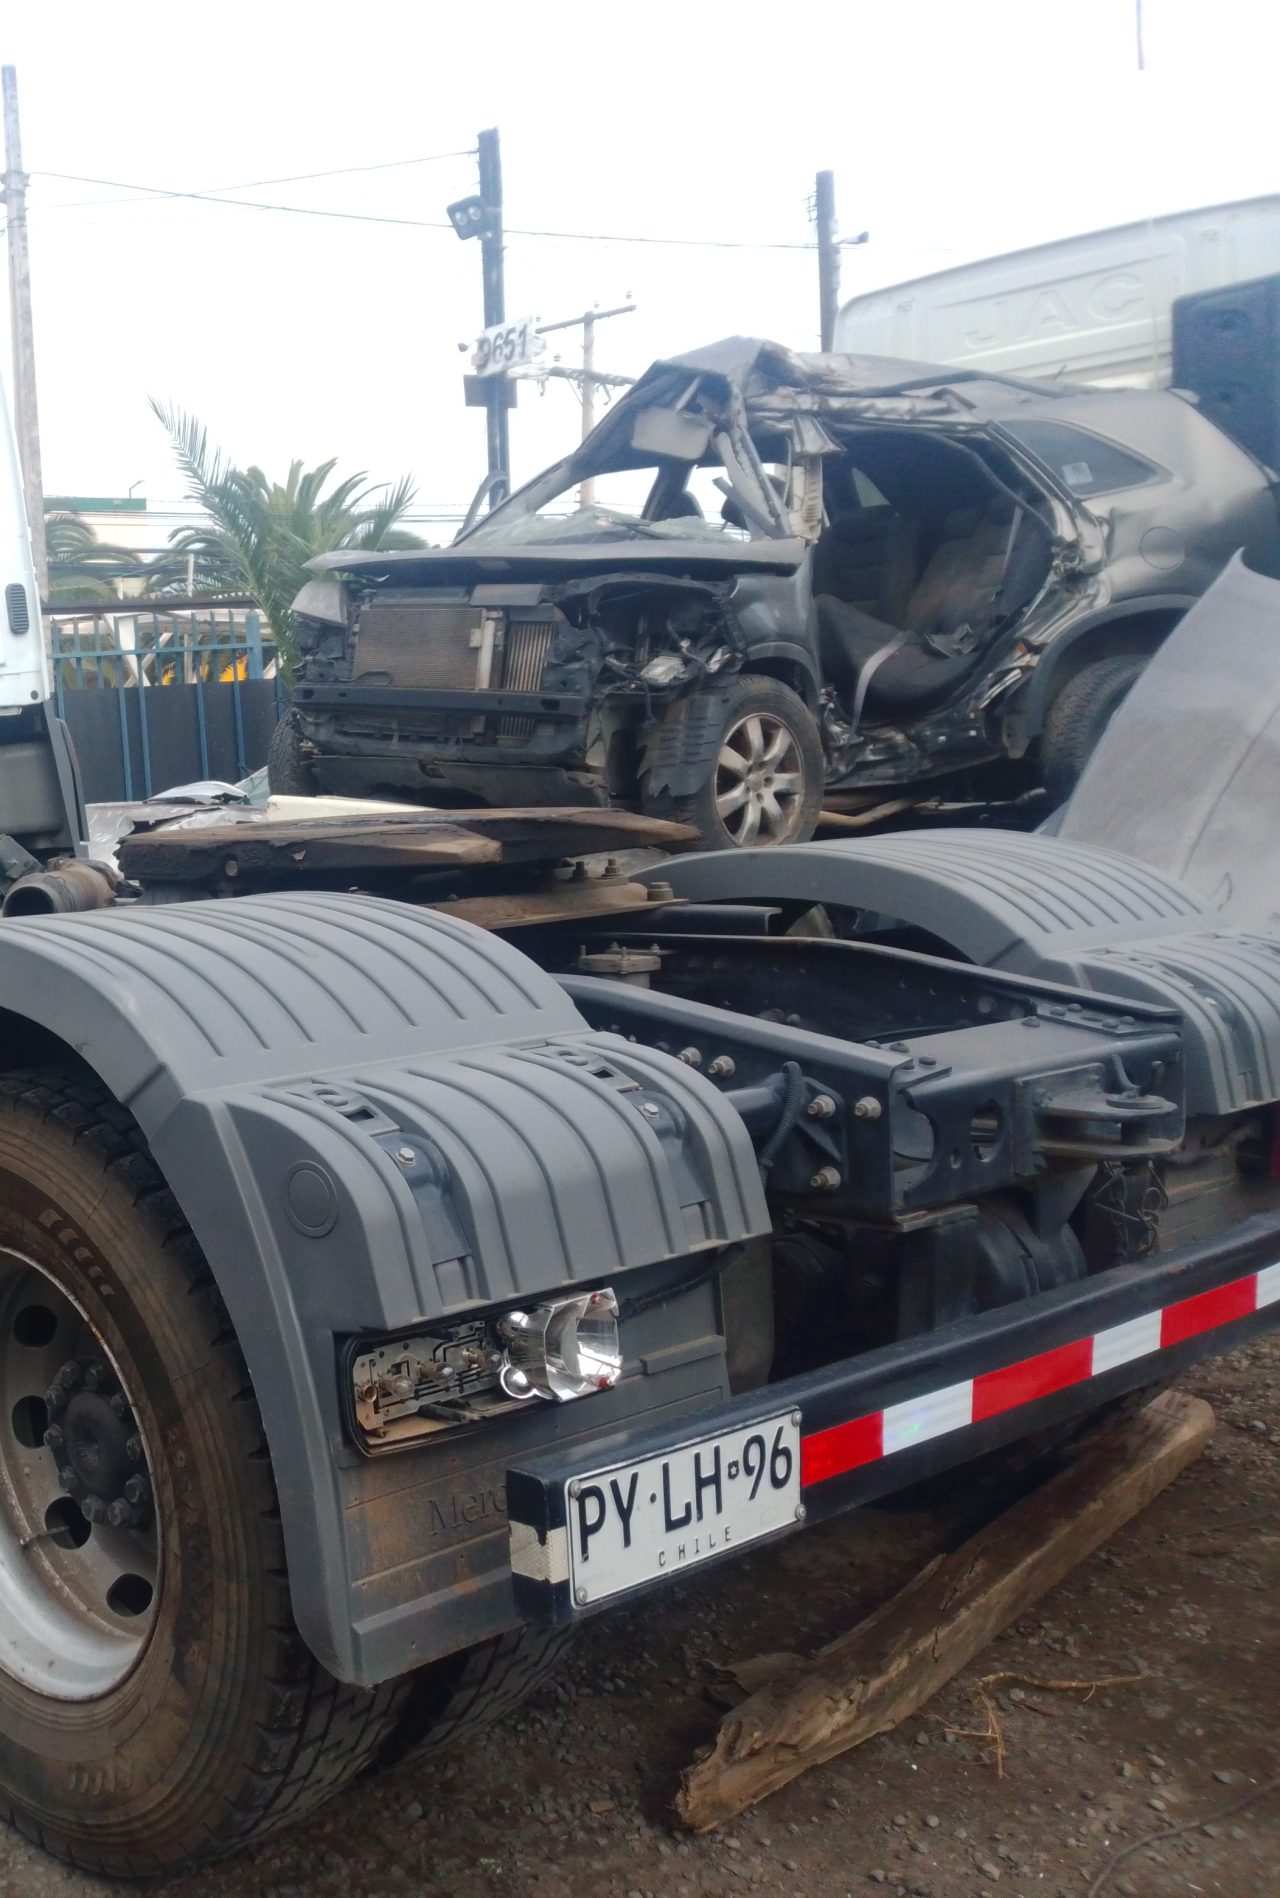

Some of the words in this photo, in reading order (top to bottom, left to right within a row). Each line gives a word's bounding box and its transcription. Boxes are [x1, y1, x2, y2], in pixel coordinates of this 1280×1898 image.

[962, 272, 1146, 349] JAC
[476, 322, 528, 370] 9651
[658, 1526, 732, 1567] CHILE
